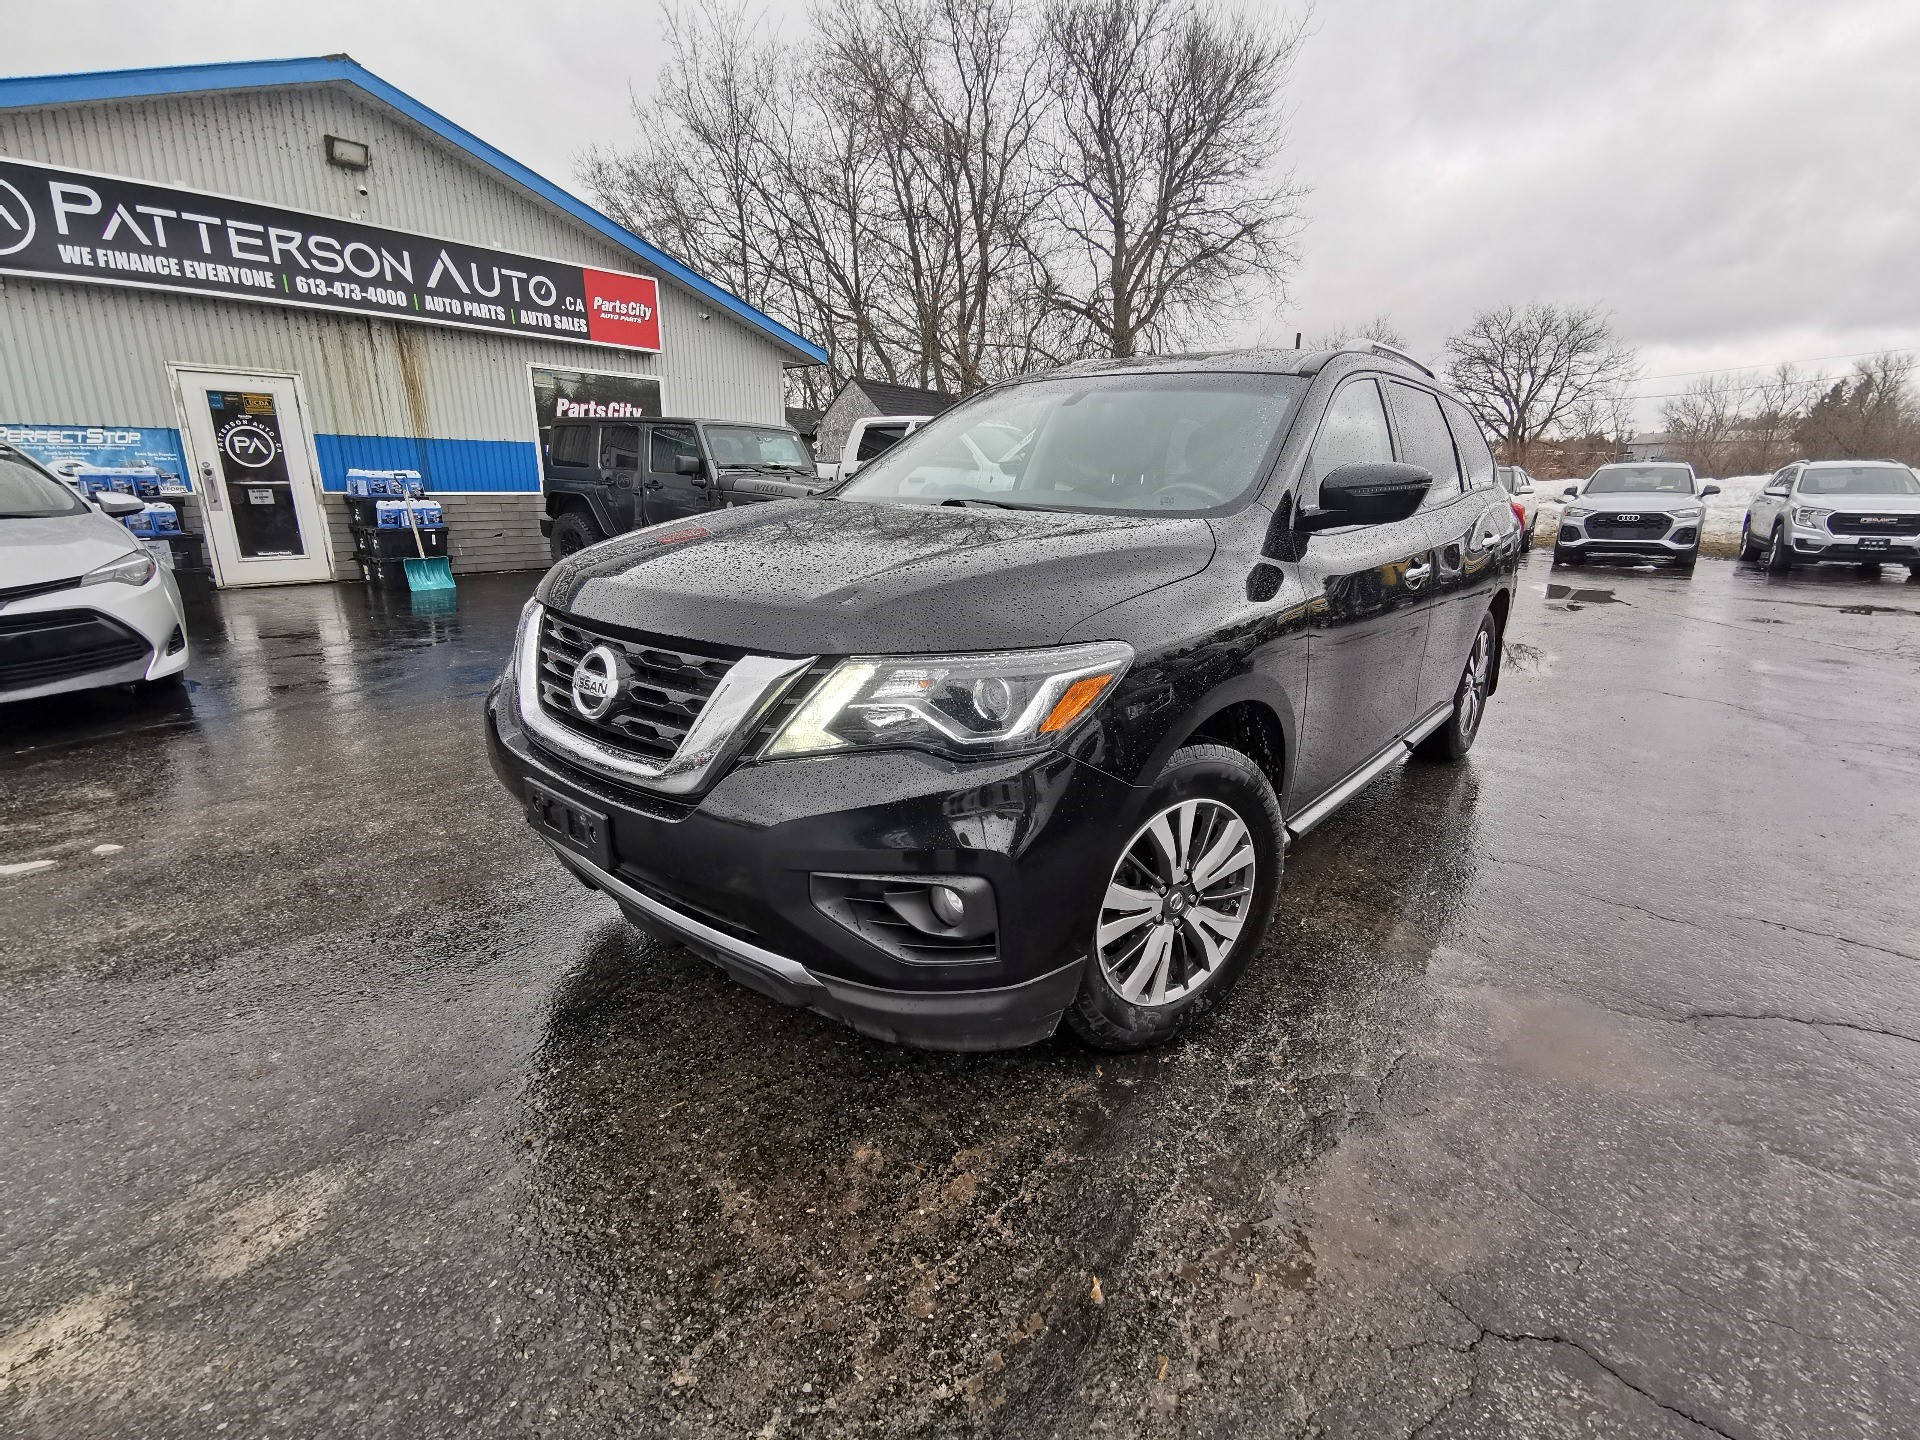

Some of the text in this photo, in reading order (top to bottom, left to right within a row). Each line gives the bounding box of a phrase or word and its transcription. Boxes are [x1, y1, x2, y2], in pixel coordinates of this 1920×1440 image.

[48, 181, 414, 284] PATTERSON
[427, 249, 557, 307] AUTO
[58, 244, 588, 333] WE FINANCE EVERYONE 613-473-4000 AUTO PARTS AUTO SALES
[600, 312, 642, 323] AUTO PARTS
[217, 419, 249, 452] PATTERSON
[252, 421, 275, 437] AUTO
[754, 484, 784, 494] WILLYS
